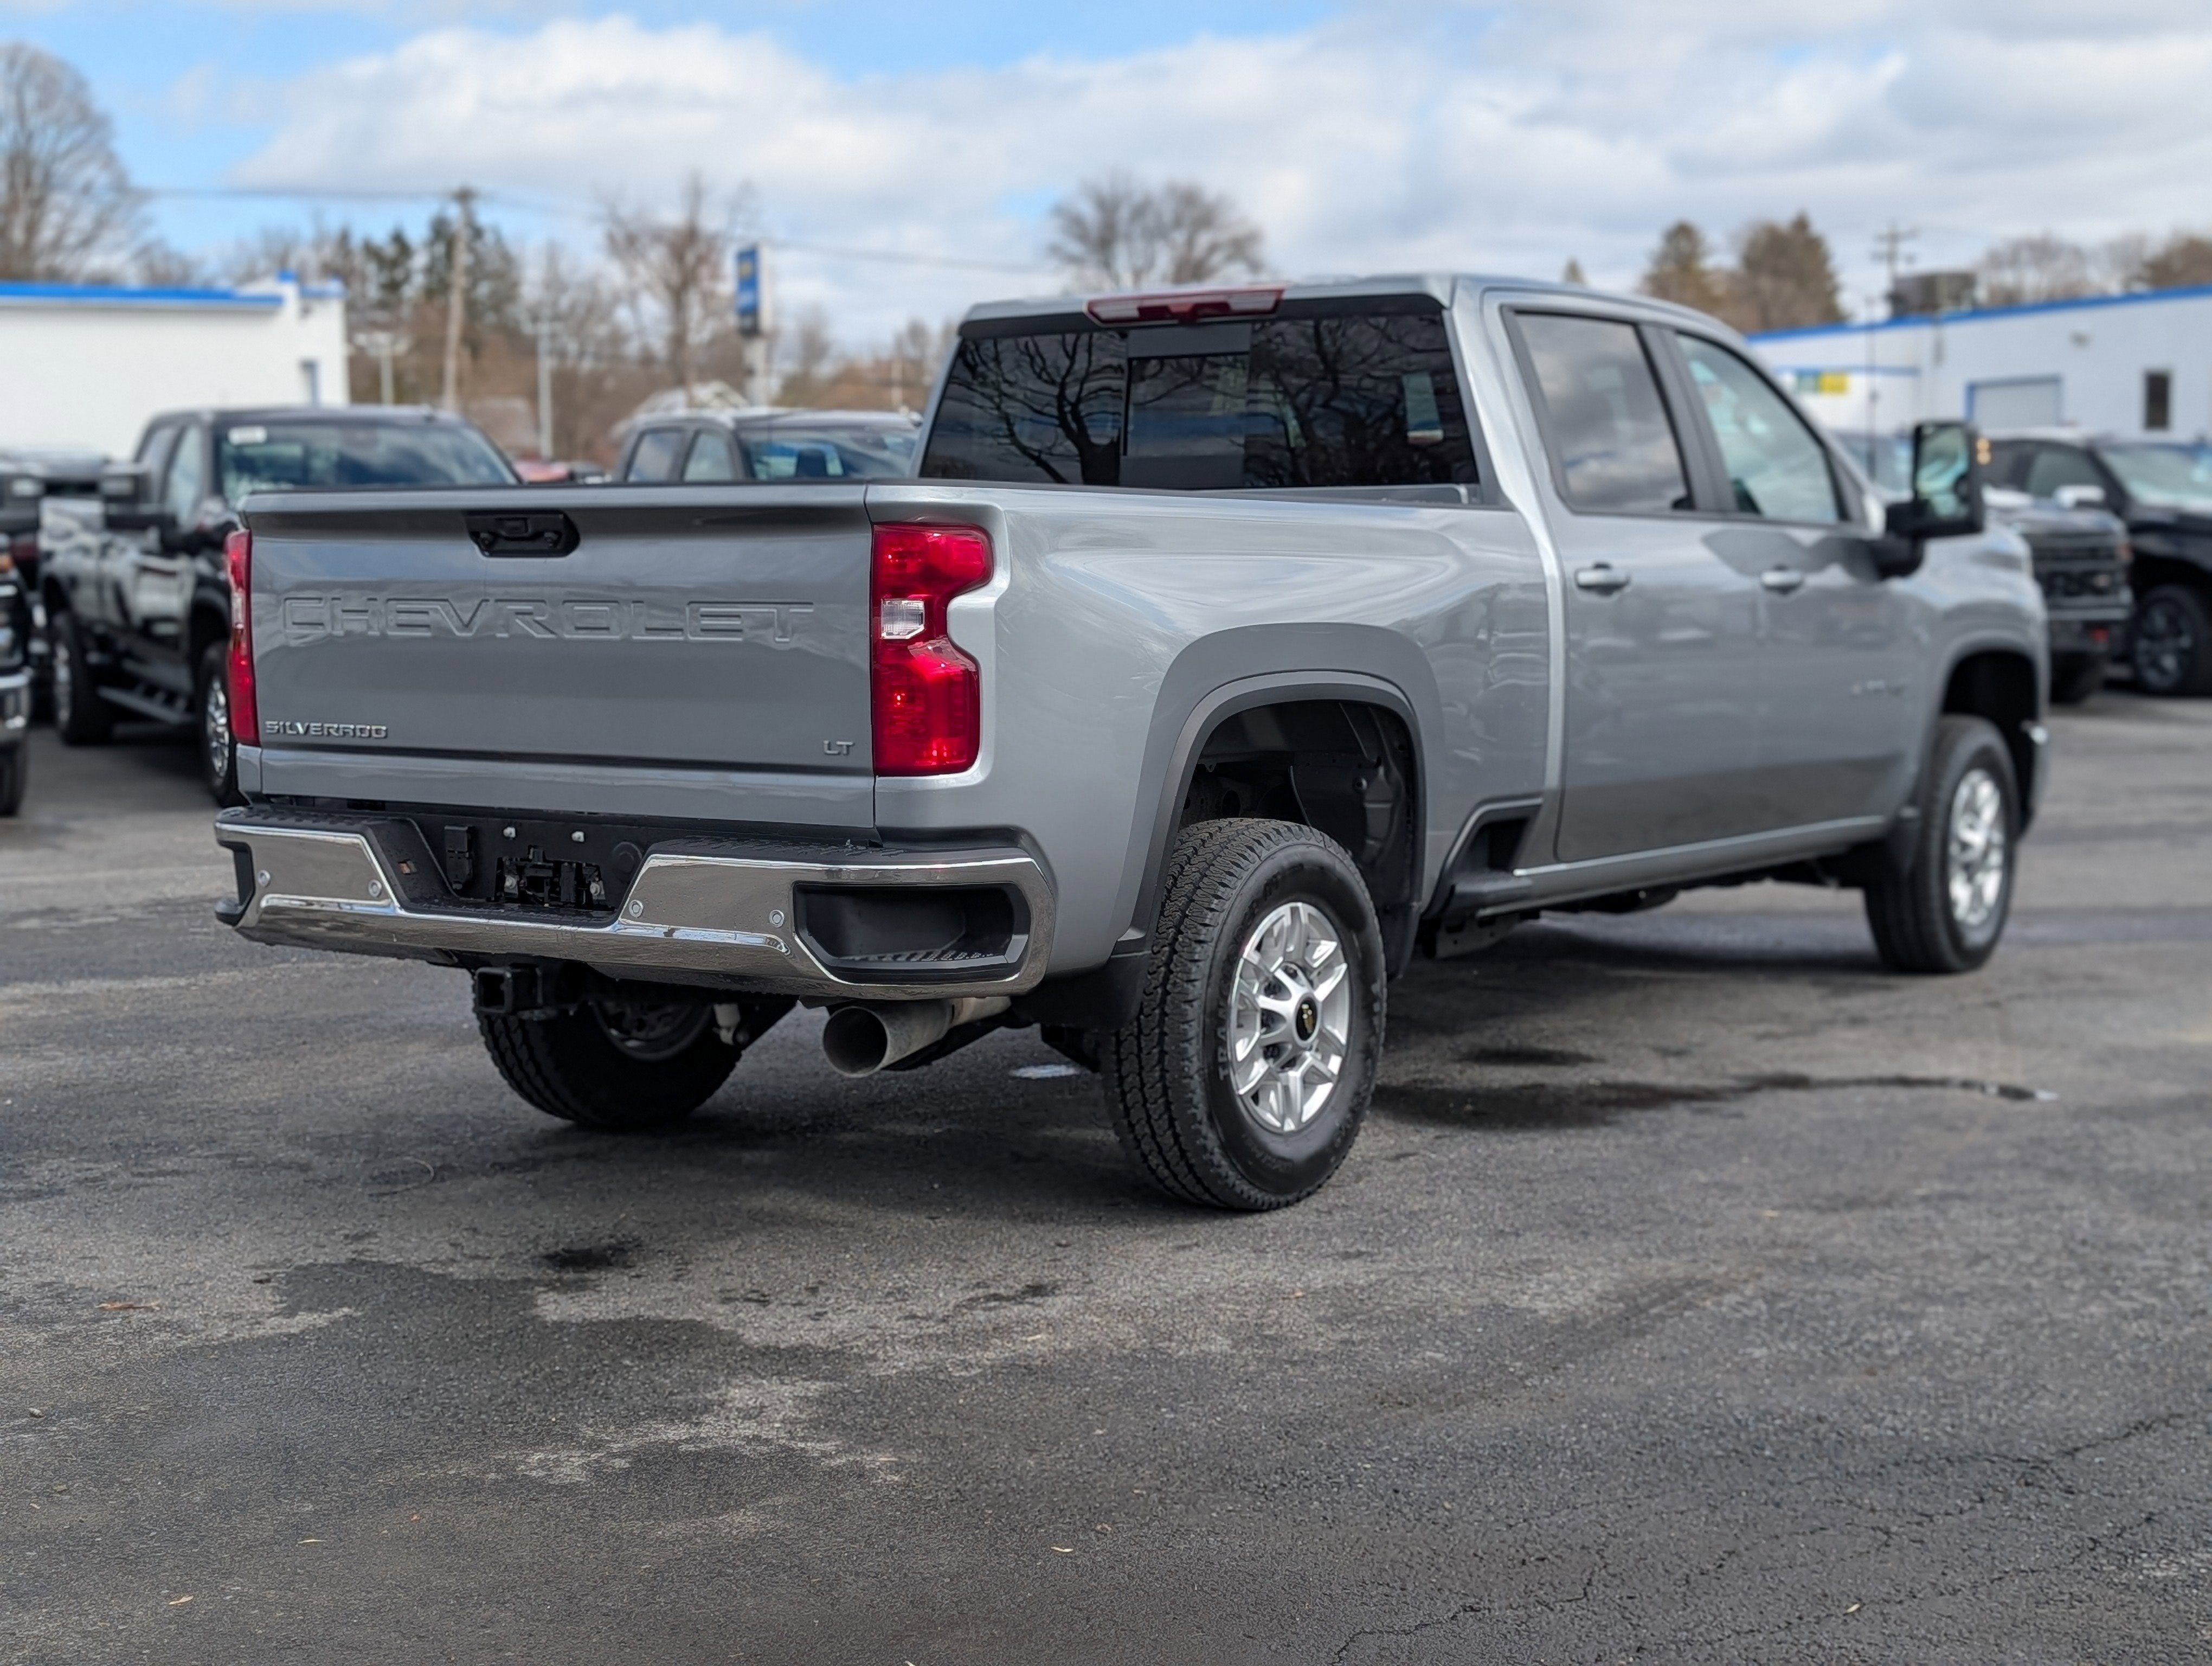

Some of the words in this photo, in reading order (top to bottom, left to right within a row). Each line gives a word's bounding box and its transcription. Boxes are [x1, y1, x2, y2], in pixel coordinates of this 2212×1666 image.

[283, 597, 814, 642] CHEVROLET
[265, 720, 388, 739] SILVERADO
[824, 740, 854, 755] LT
